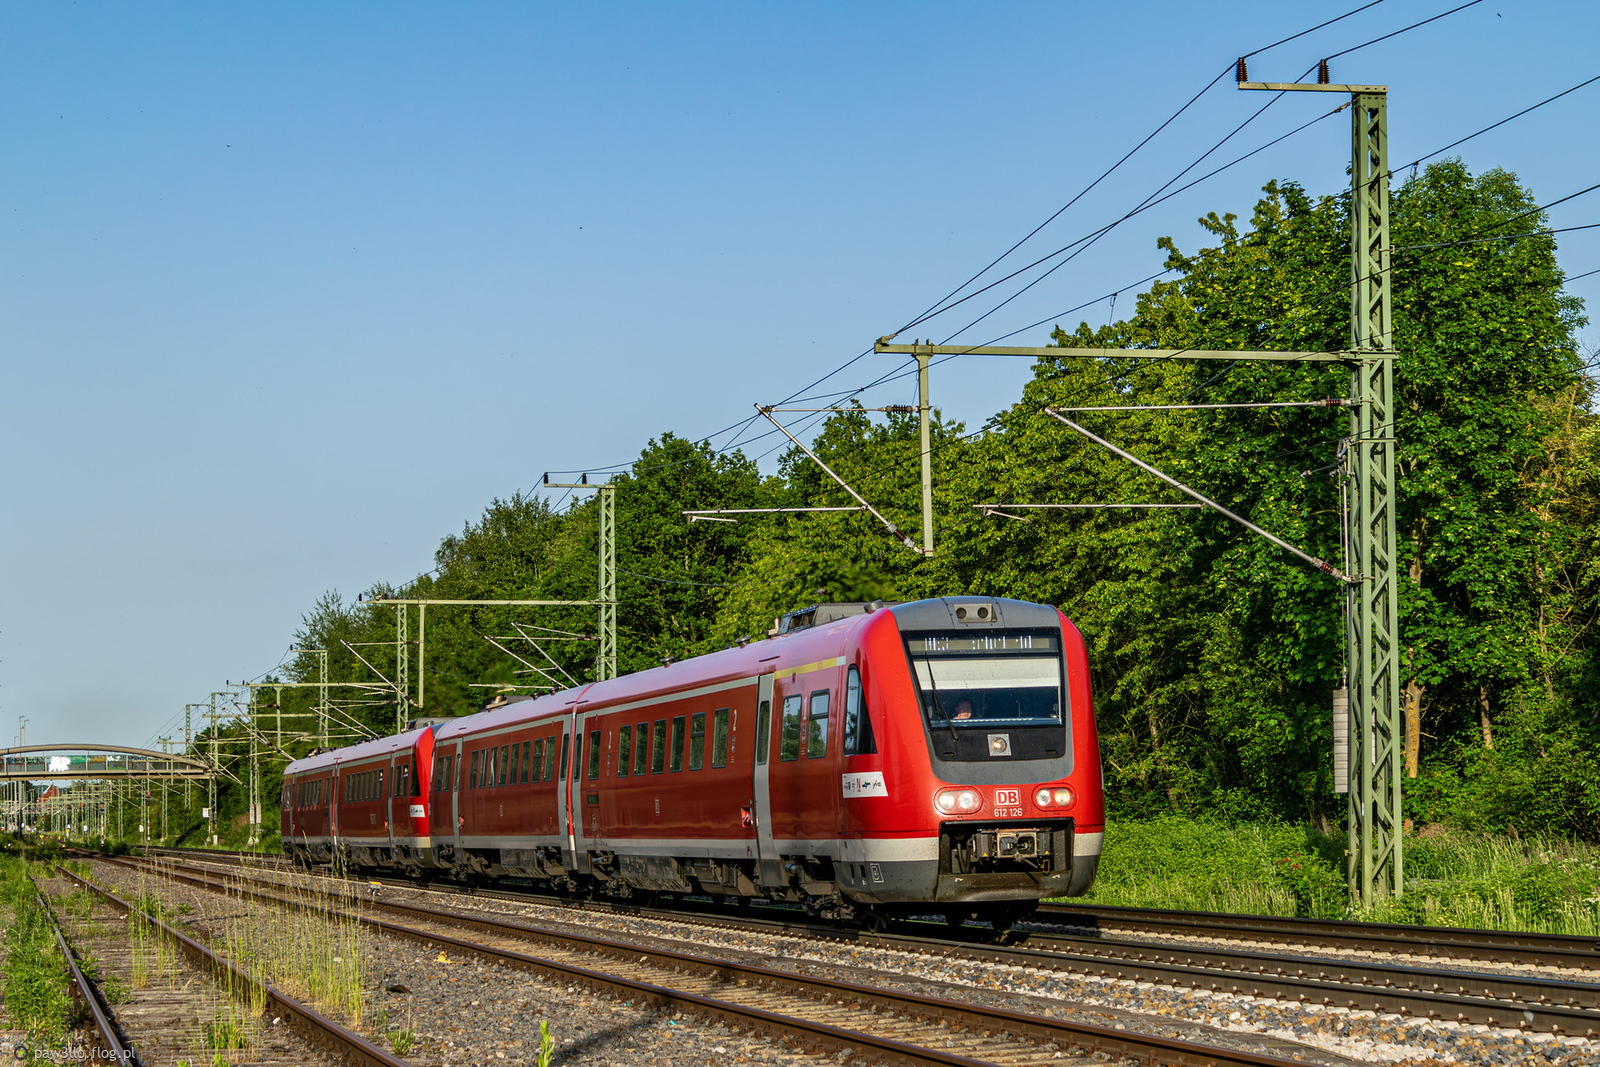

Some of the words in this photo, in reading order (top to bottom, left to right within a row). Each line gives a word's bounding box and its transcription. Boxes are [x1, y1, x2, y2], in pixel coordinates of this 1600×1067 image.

[997, 791, 1018, 804] DB
[994, 808, 1008, 818] 612
[1009, 807, 1023, 817] 126
